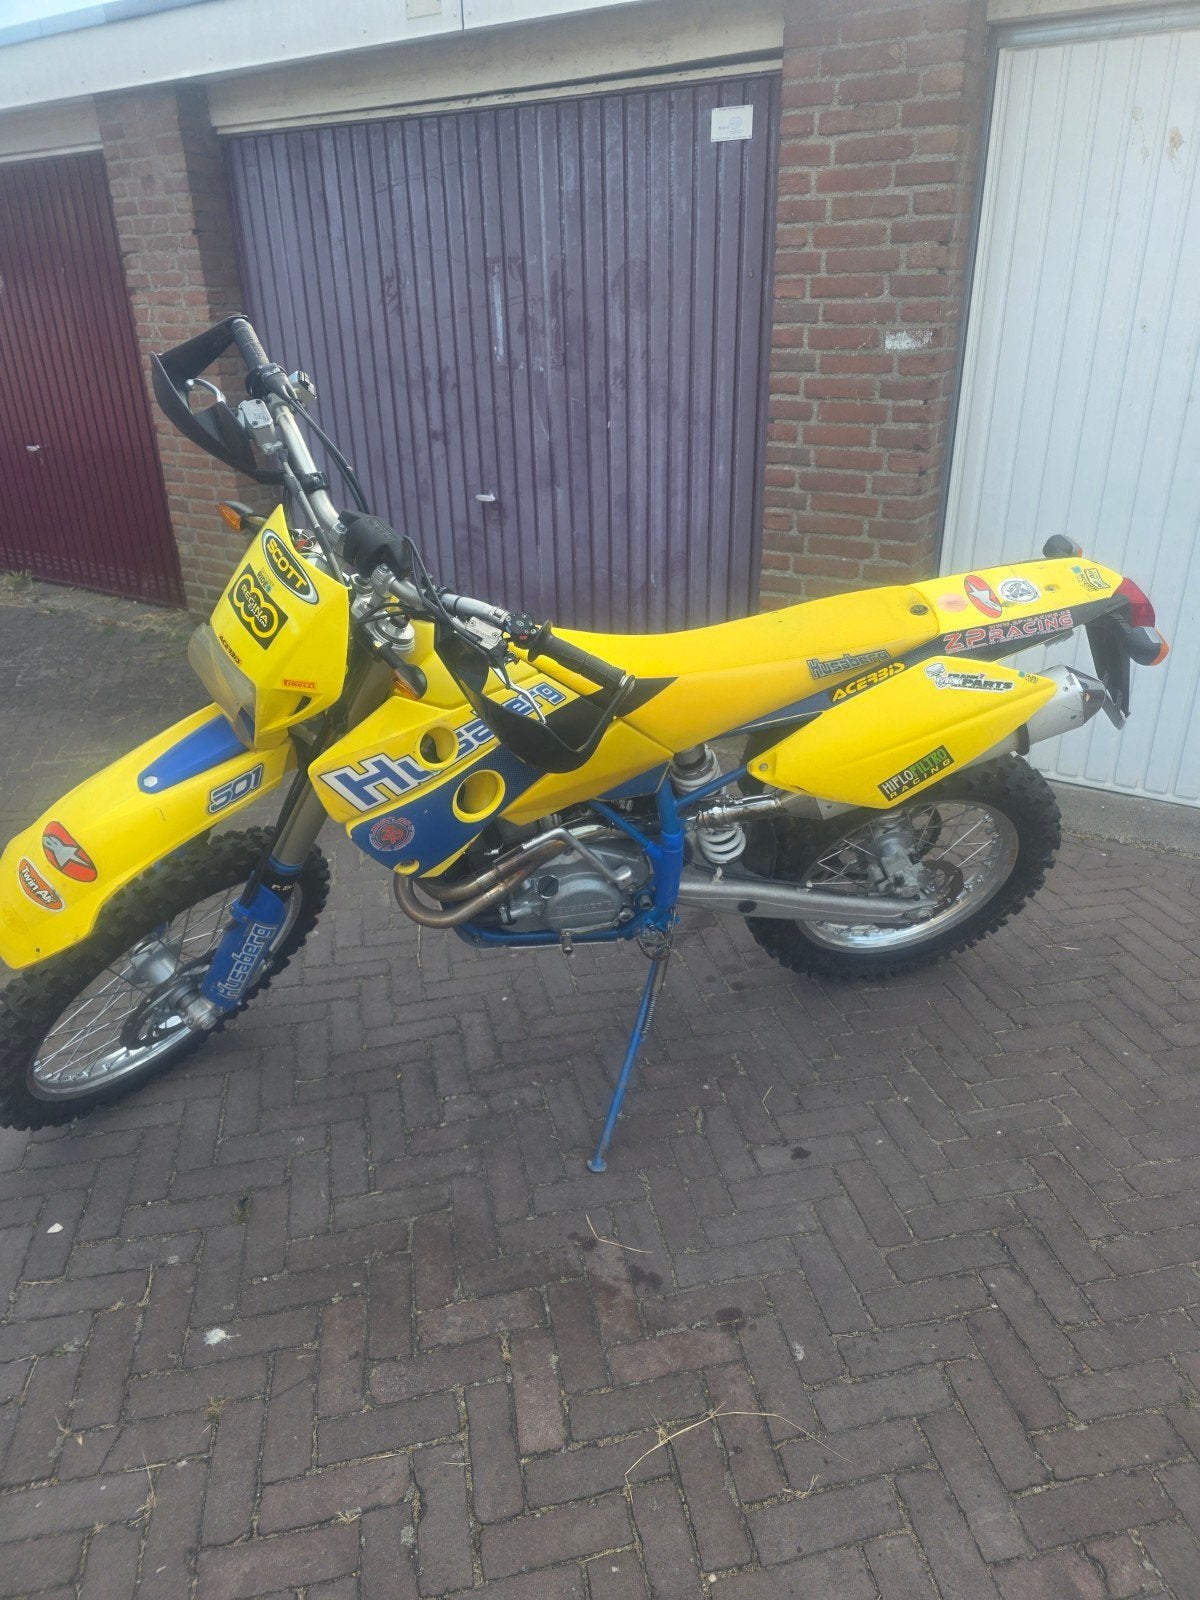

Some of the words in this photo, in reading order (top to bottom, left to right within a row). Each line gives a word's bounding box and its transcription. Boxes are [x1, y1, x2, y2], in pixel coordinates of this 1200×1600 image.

[266, 540, 308, 589] SCOTT
[241, 584, 268, 624] REGINA
[806, 649, 891, 680] Husaberg
[832, 661, 906, 702] ACERBIS
[208, 763, 264, 814] 501
[881, 745, 949, 795] HIFLOFILTRO
[889, 758, 951, 800] RACING
[21, 866, 39, 891] Twin
[36, 889, 57, 903] Air
[217, 924, 277, 1000] Husaberg
